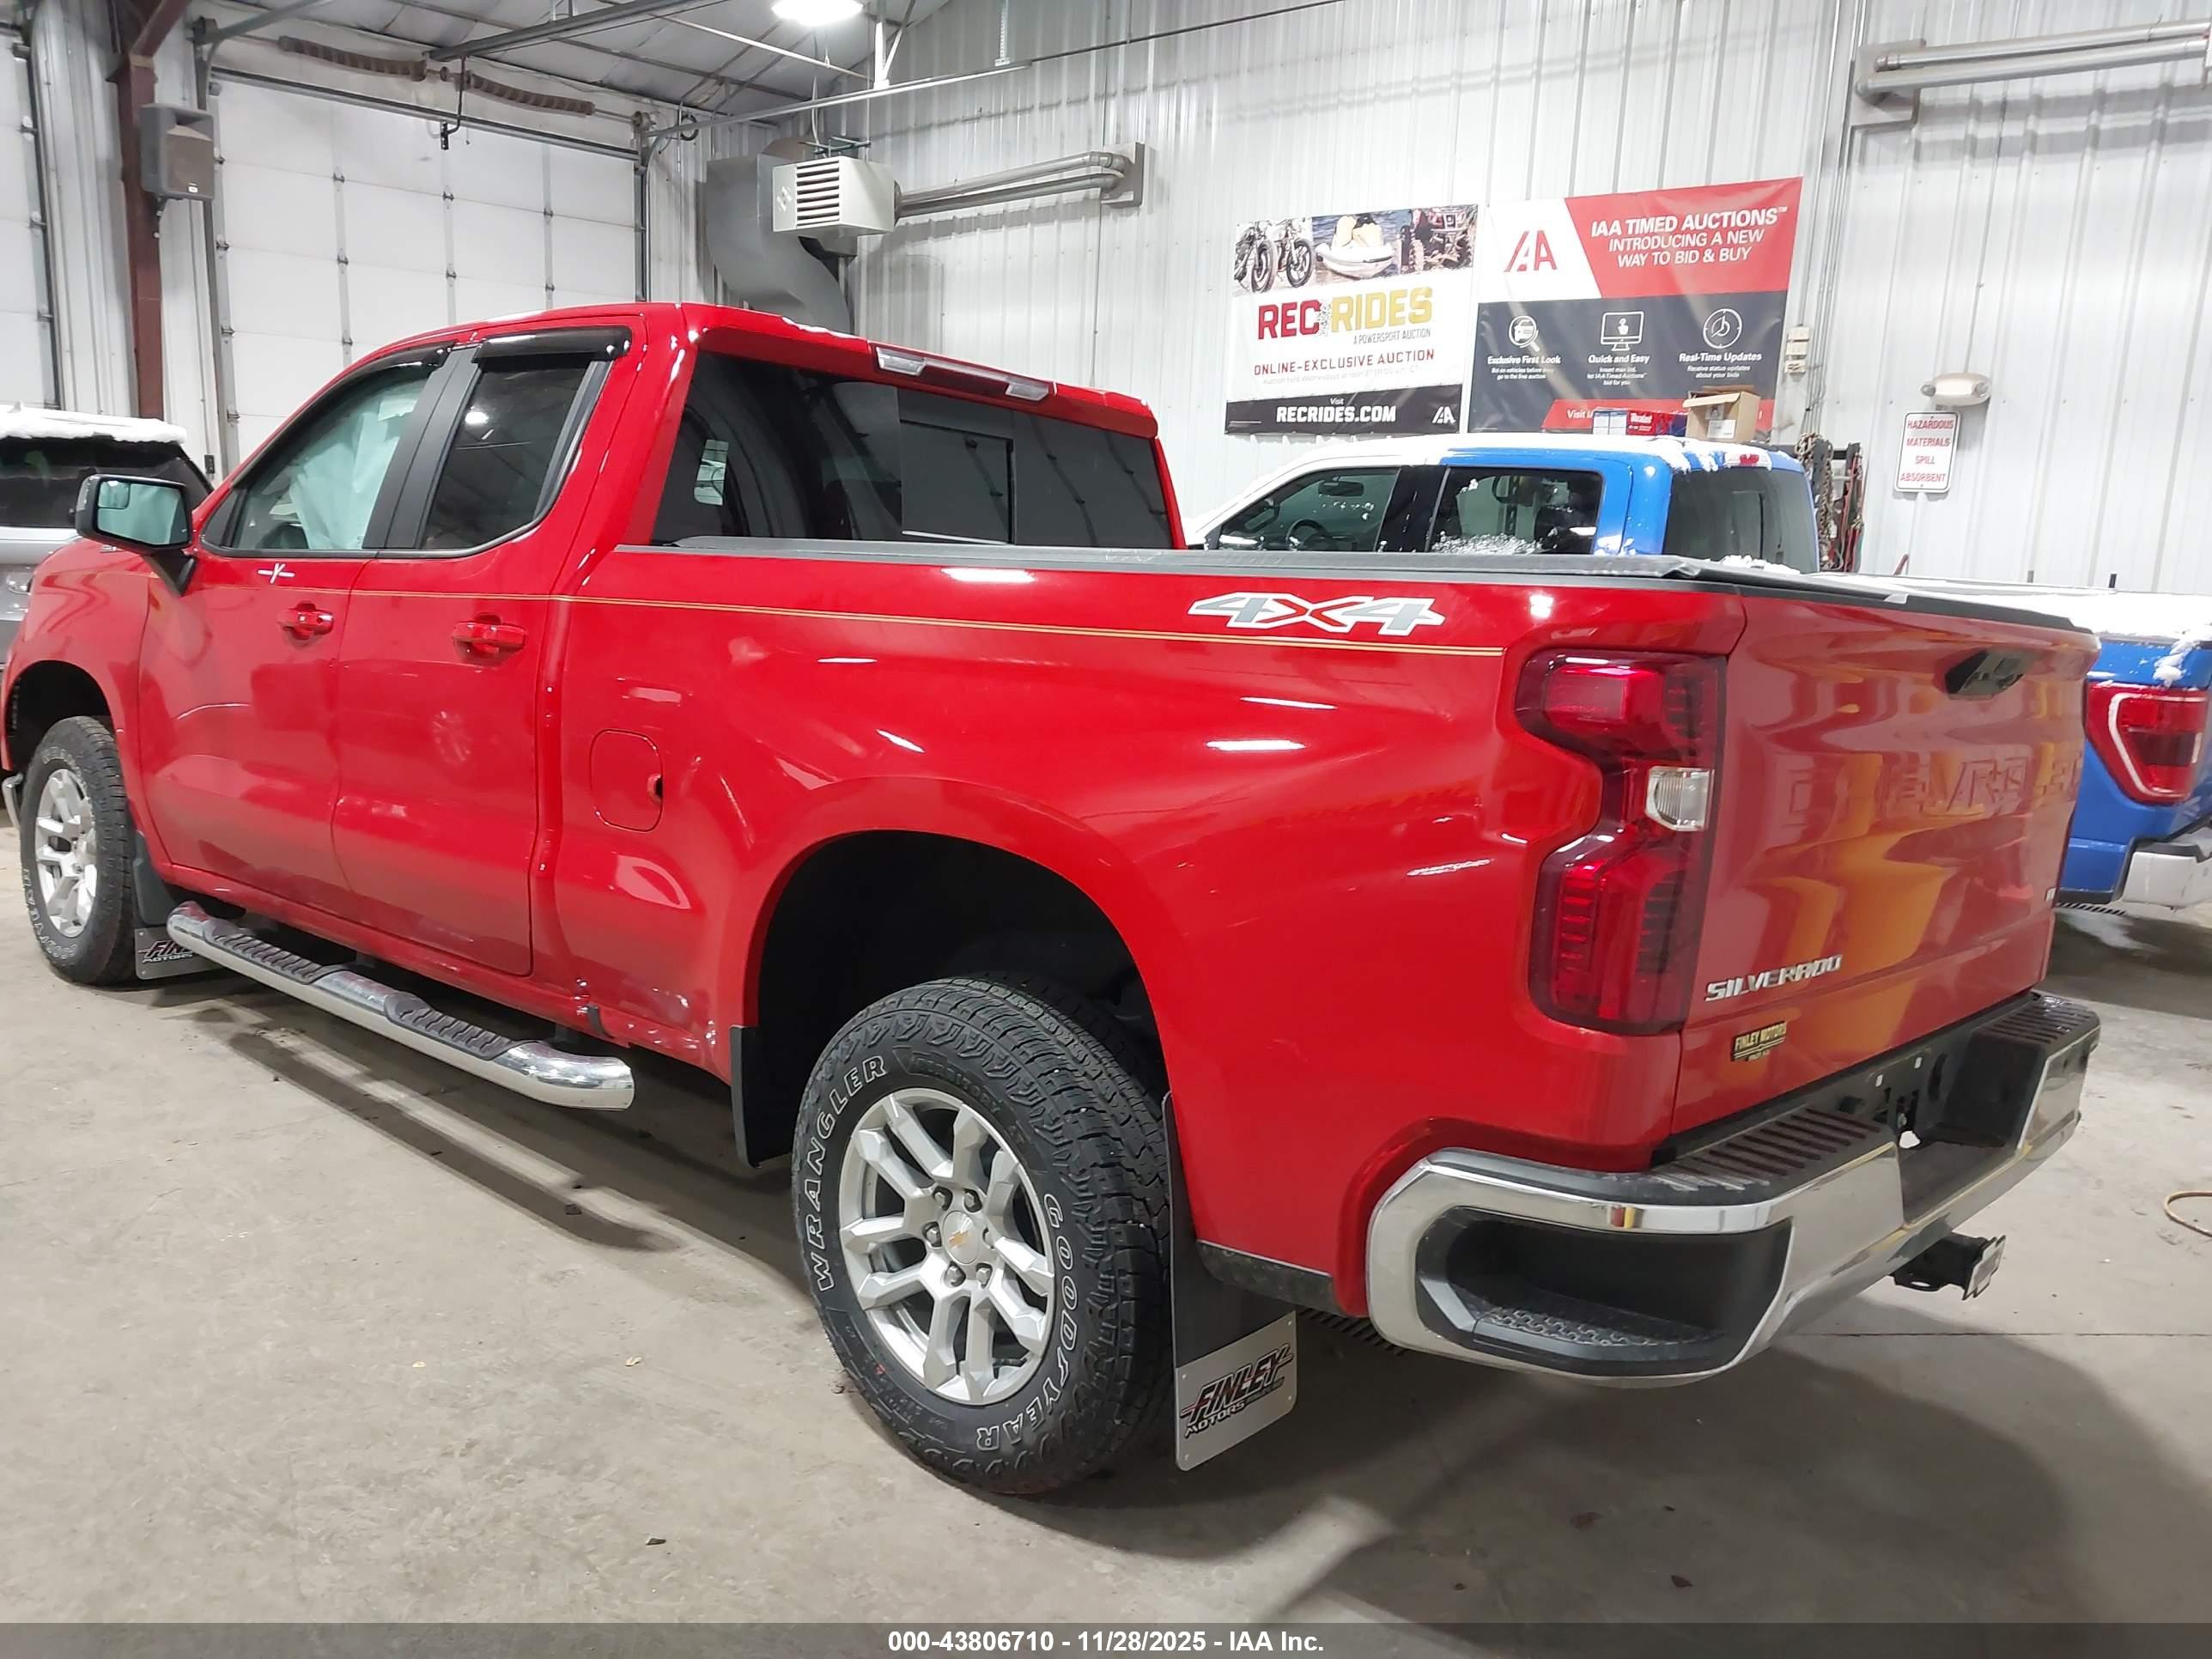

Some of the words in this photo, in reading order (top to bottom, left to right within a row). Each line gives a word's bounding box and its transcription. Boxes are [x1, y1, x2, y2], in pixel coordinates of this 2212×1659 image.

[1591, 218, 1622, 238] IAA
[1625, 216, 1678, 235] TIMED
[1608, 233, 1708, 252] INTRODUCING
[1711, 232, 1723, 246] A
[1727, 228, 1765, 244] NEW
[1617, 252, 1650, 268] WAY
[1651, 250, 1671, 265] TO
[1674, 248, 1698, 264] BID
[1703, 247, 1716, 263] &
[1718, 246, 1753, 262] BUY
[1257, 299, 1322, 340] REC
[1331, 287, 1433, 333] RIDES
[1358, 331, 1401, 344] POWERSPORT
[1401, 327, 1431, 341] AUCTION
[1255, 354, 1374, 376] ONLINE-EXCLUSIVE
[1377, 349, 1435, 365] AUCTION
[1487, 355, 1521, 364] Exclusive
[1522, 355, 1539, 364] First
[1540, 354, 1561, 364] Look
[1588, 354, 1613, 363] Quick
[1613, 355, 1630, 363] and
[1631, 354, 1650, 364] Easy
[1679, 352, 1722, 362] Real-Time
[1723, 352, 1763, 363] Updates
[1330, 398, 1345, 406] Visit
[1276, 404, 1397, 423] RECRIDES.COM
[1566, 409, 1586, 419] Visit
[1907, 419, 1954, 429] HAZARDOUS
[1905, 438, 1951, 447] MATERIALS
[1915, 455, 1936, 465] SPILL
[1899, 472, 1947, 482] ABSORBENT
[1705, 954, 1843, 1002] SILVERADO
[805, 1054, 887, 1292] WRANGLER
[976, 1194, 1079, 1452] GOODYEAR
[1181, 1343, 1294, 1428] FINLEY
[1184, 1400, 1246, 1439] MOTORS
